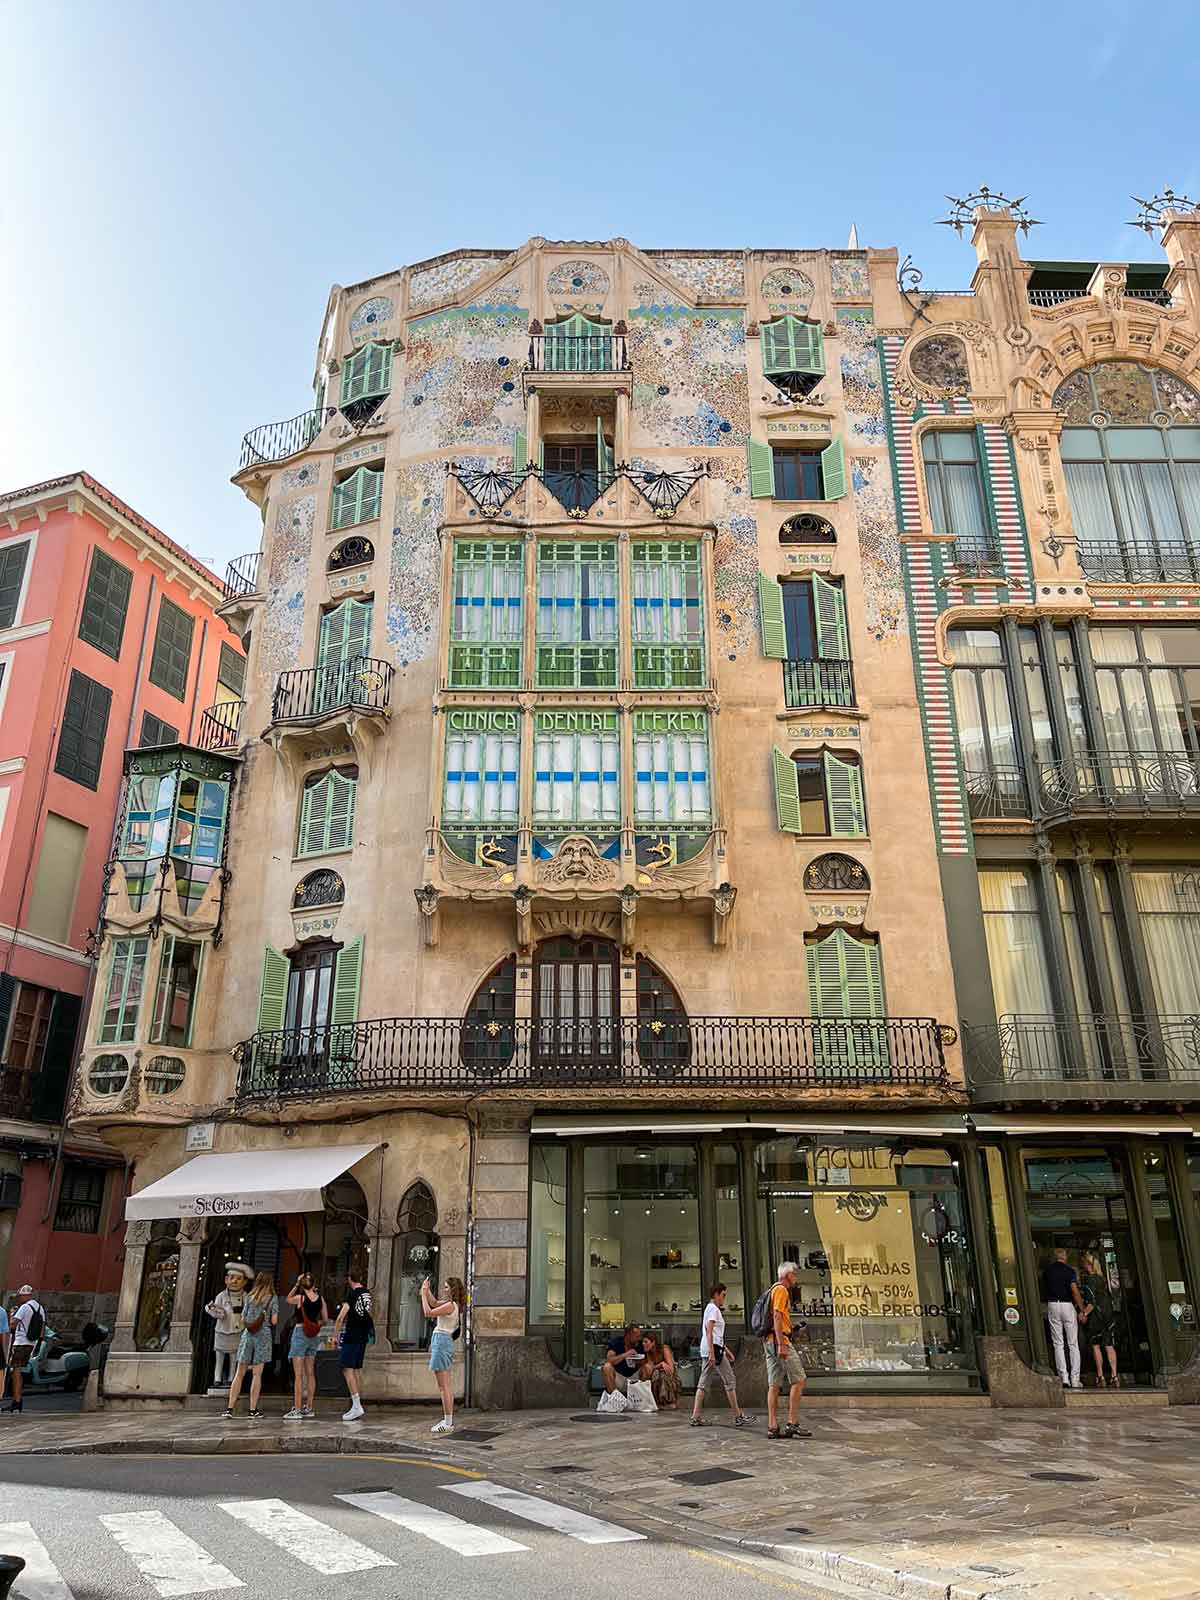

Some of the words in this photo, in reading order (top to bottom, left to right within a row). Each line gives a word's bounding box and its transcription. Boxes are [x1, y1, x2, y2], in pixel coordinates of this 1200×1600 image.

[450, 711, 516, 730] CLINICA
[542, 711, 612, 730] DENTAL
[840, 1262, 911, 1276] REBAJAS
[822, 1284, 872, 1298] HASTA
[879, 1284, 914, 1298] -50%
[882, 1303, 950, 1317] PRECIOS
